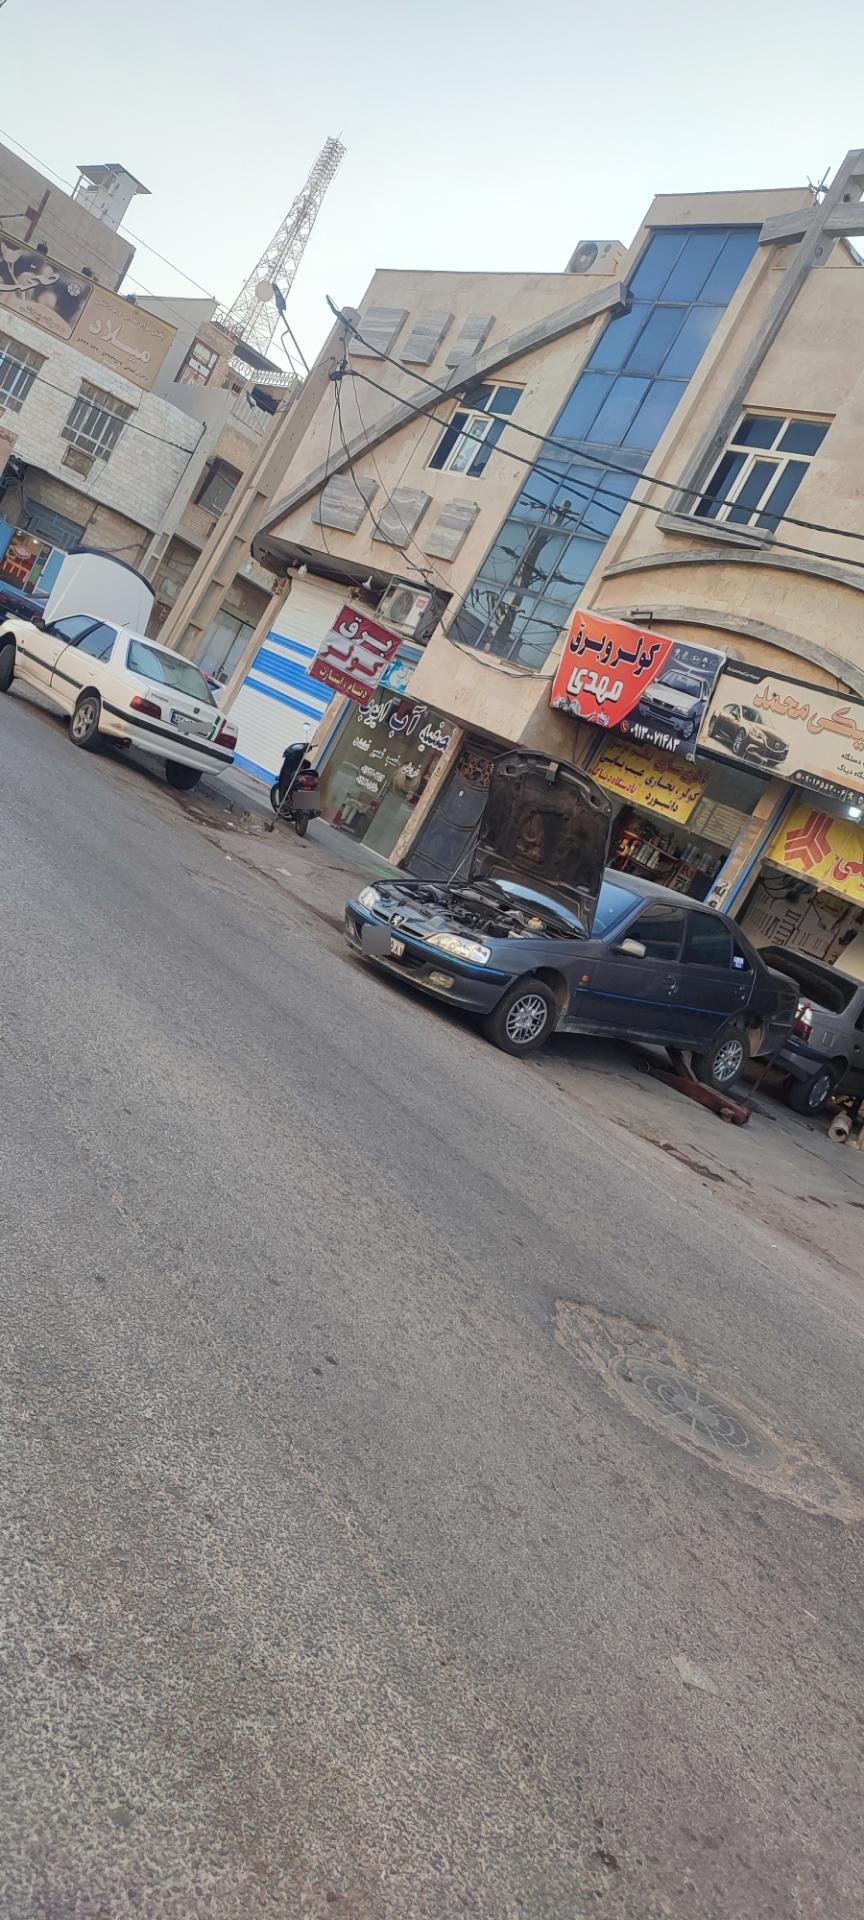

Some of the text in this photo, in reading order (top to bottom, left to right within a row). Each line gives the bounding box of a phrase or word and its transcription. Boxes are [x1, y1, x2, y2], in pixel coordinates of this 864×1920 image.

[88, 319, 151, 364] میلاد
[339, 616, 393, 658] برق
[568, 622, 607, 662] برق
[610, 635, 662, 678] کولر
[319, 644, 384, 677] کولر
[566, 665, 624, 706] مهدی
[752, 684, 811, 721] محمد
[388, 705, 428, 738] آب
[644, 776, 675, 793] بخاری
